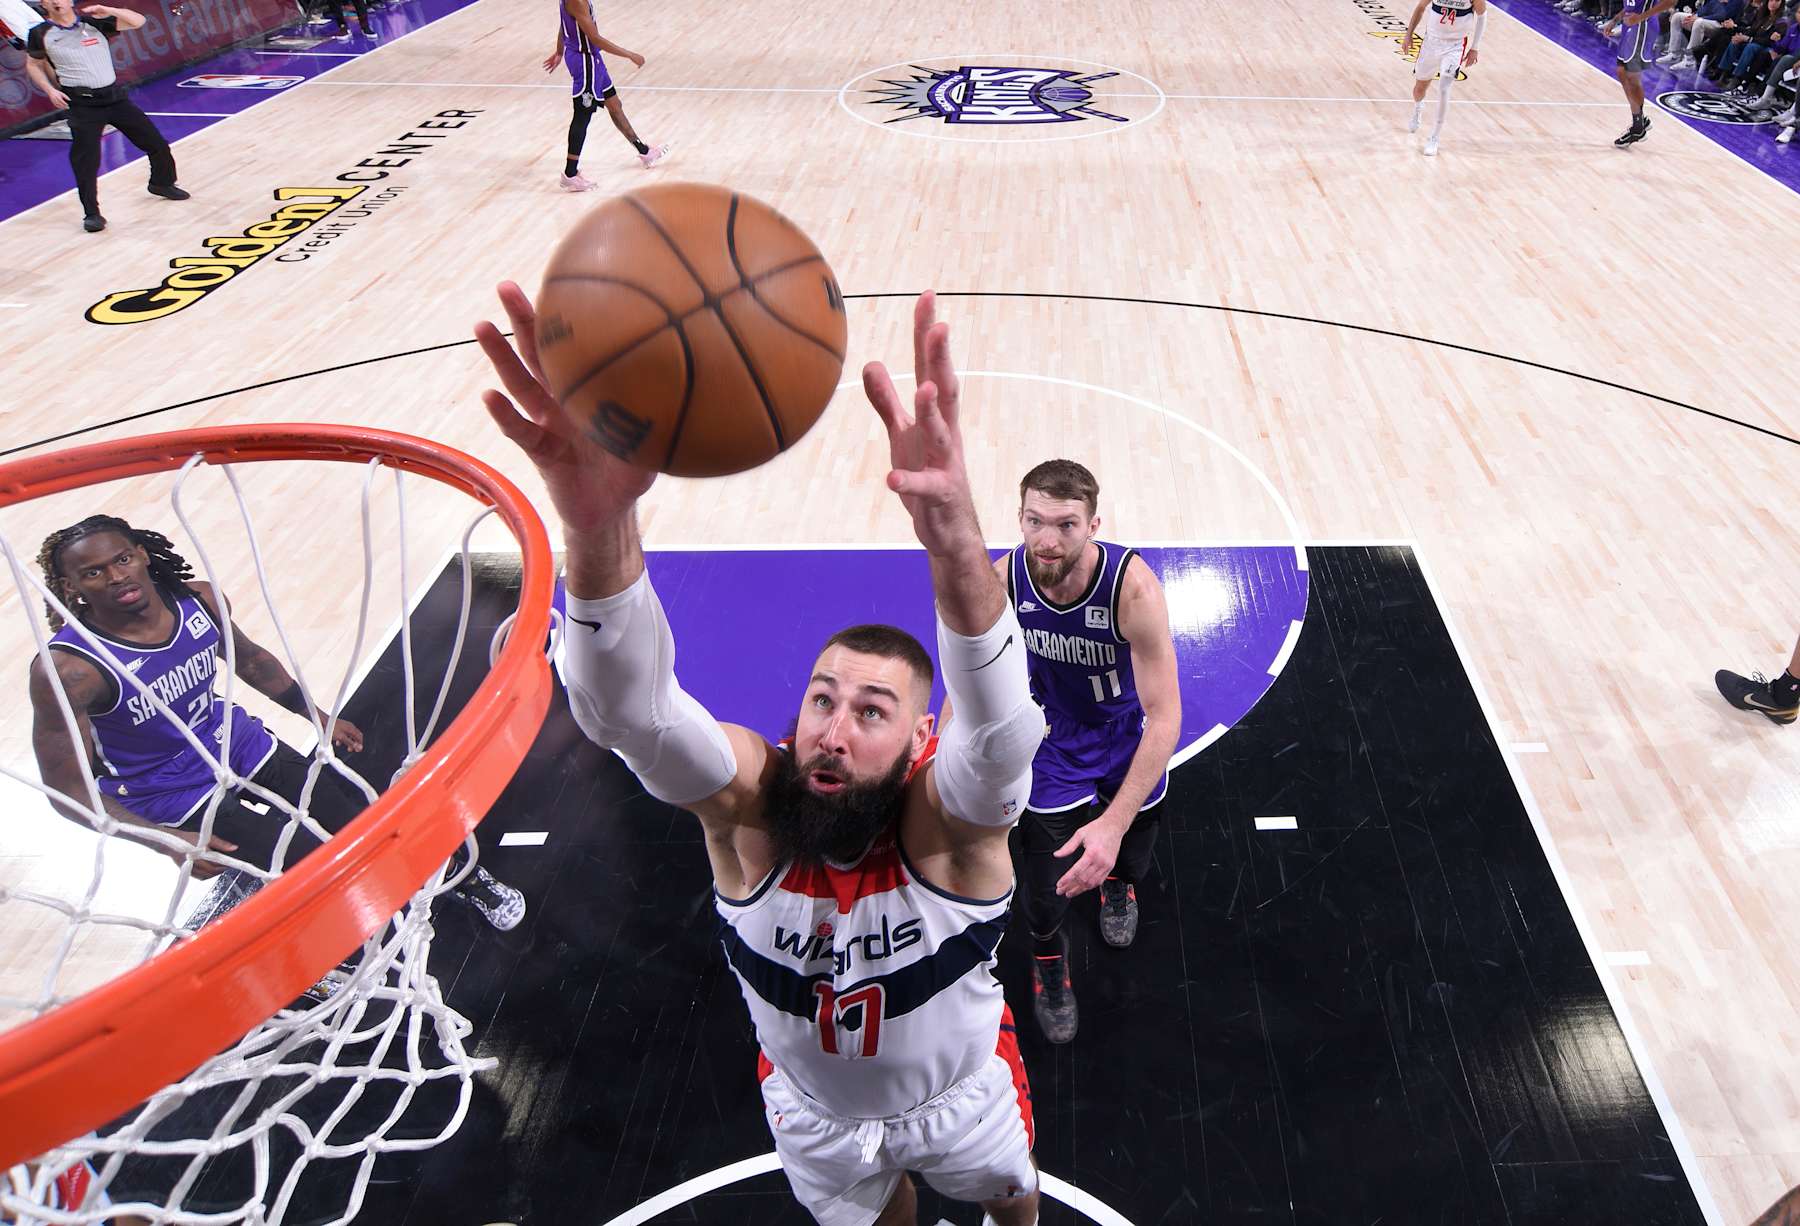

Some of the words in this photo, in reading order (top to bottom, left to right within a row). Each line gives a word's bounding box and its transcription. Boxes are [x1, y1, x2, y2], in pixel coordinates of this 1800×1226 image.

[1439, 7, 1456, 25] 24
[960, 68, 1062, 121] KINGS
[336, 109, 485, 182] CENTER
[275, 222, 357, 262] Credit
[338, 186, 408, 218] Union
[126, 640, 219, 726] SACRAMENT
[1088, 669, 1122, 703] 11
[813, 980, 886, 1058] 17
